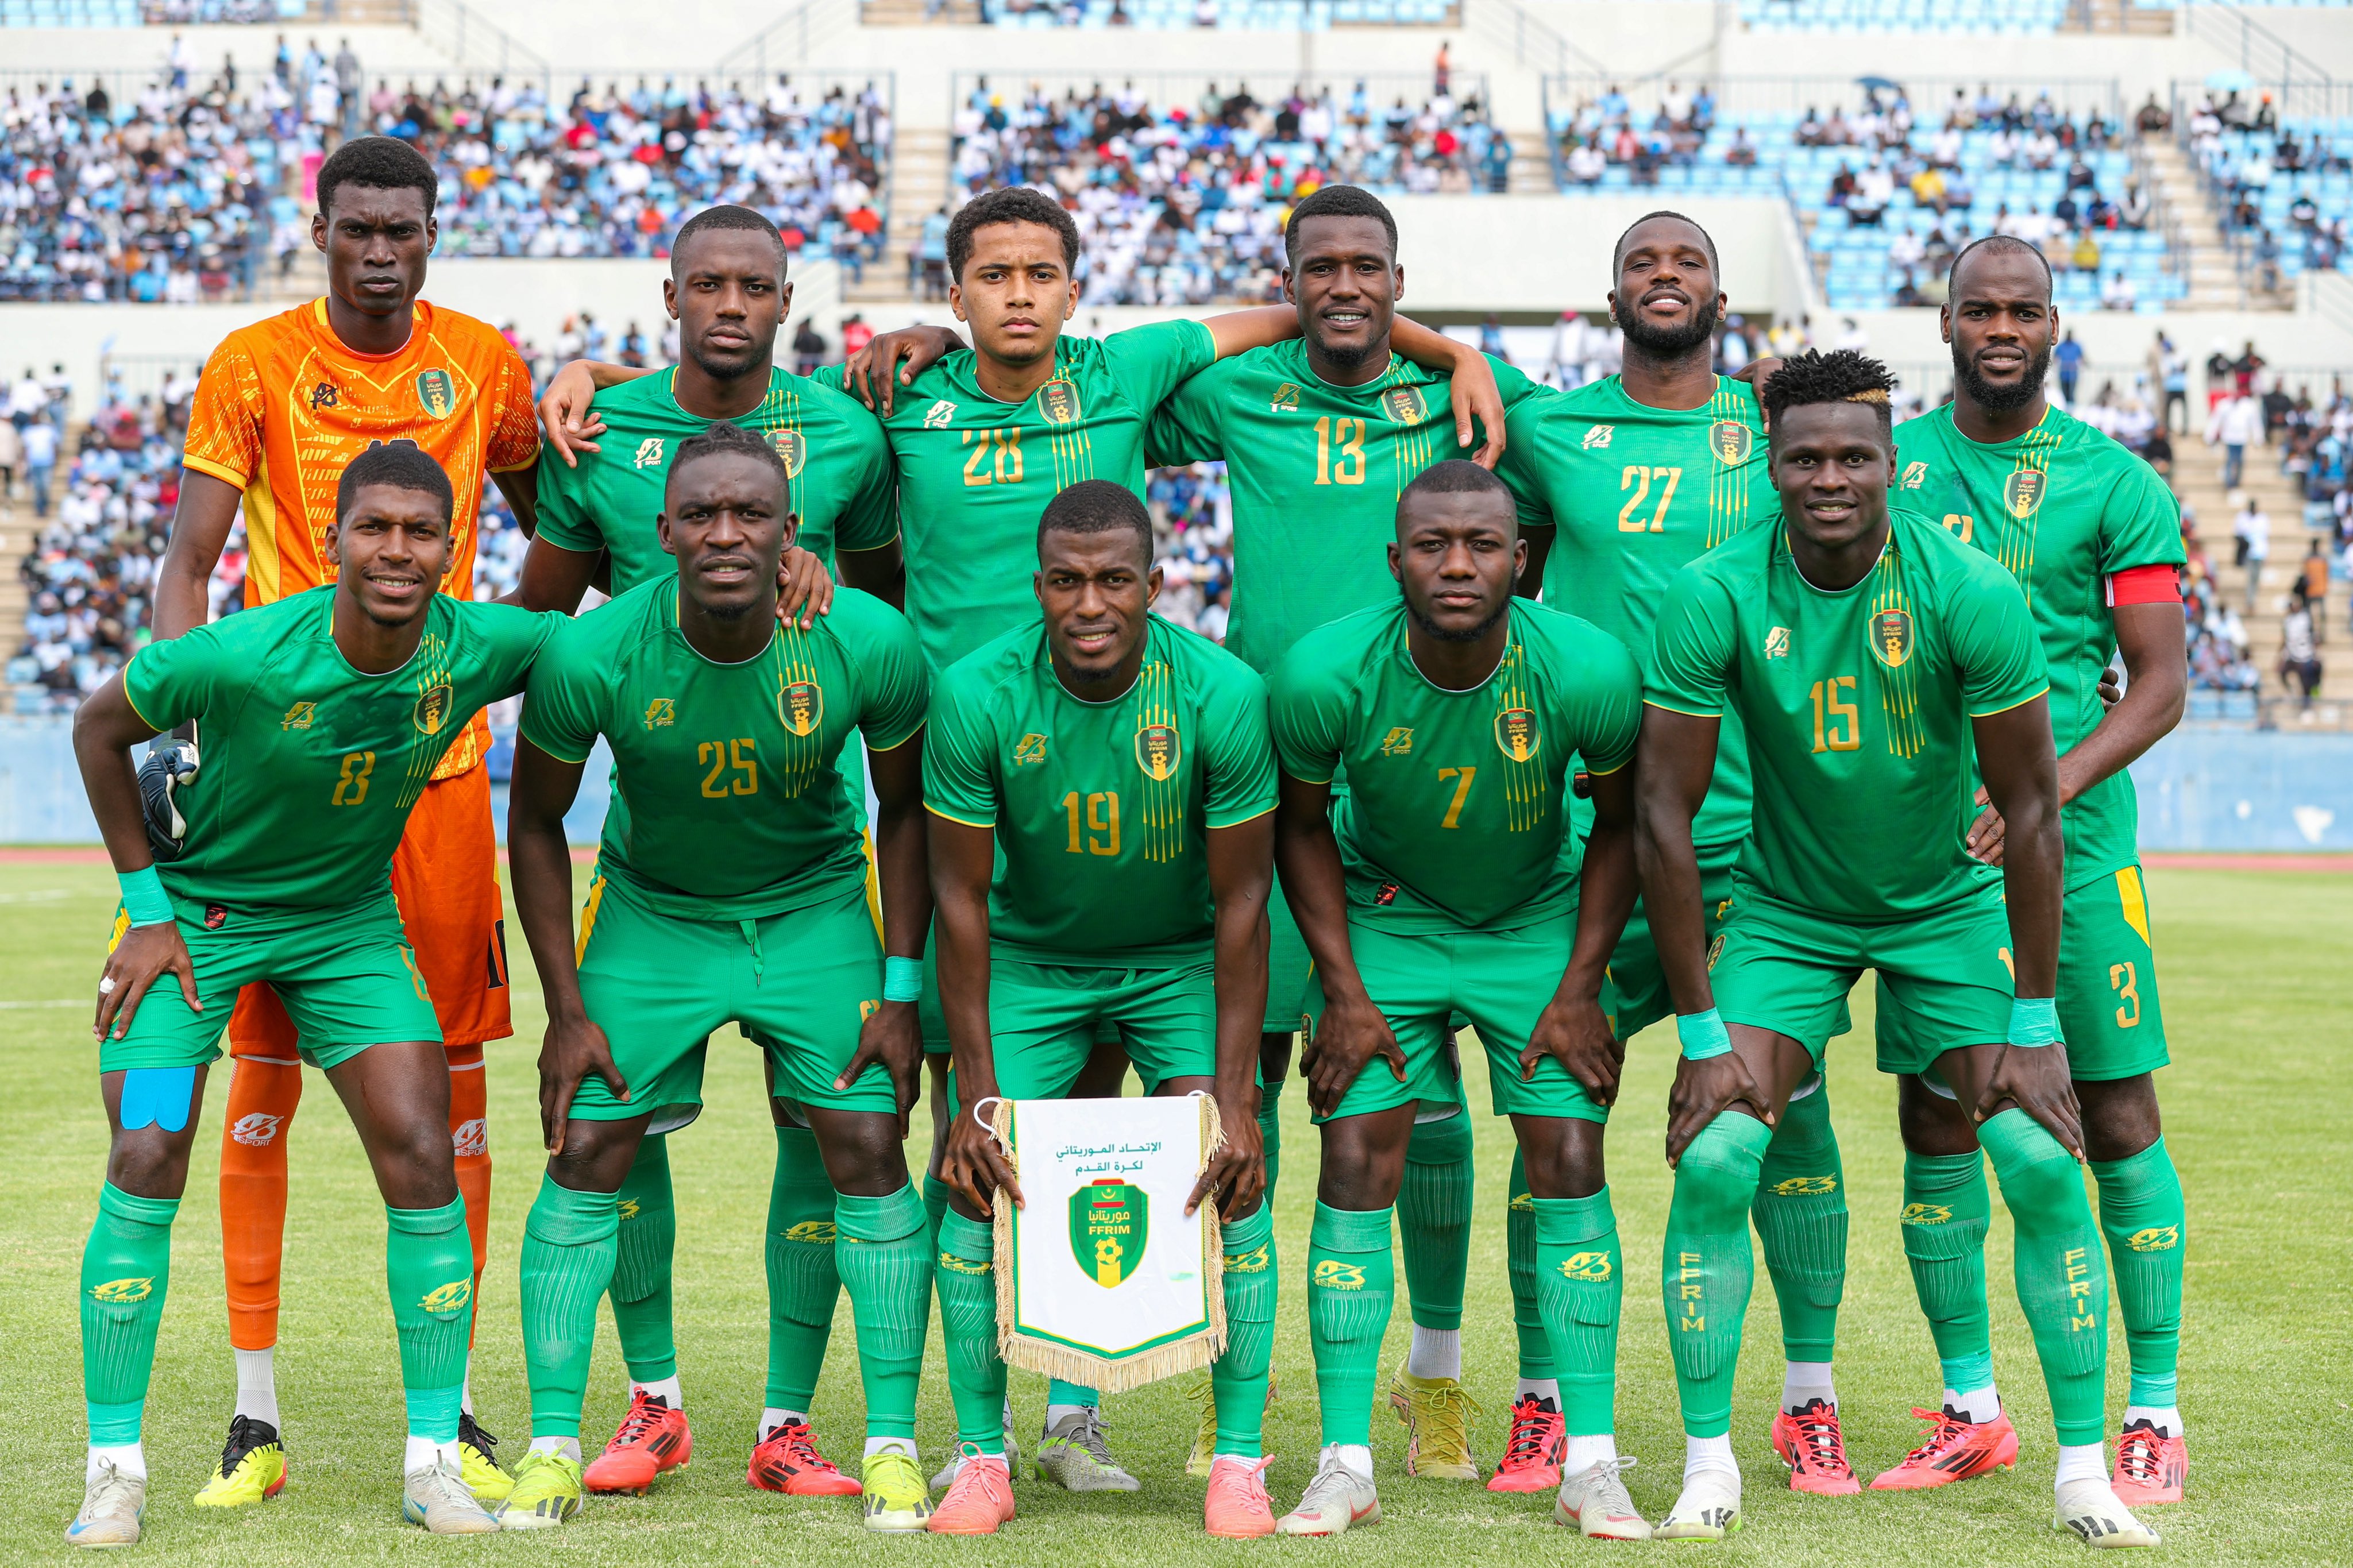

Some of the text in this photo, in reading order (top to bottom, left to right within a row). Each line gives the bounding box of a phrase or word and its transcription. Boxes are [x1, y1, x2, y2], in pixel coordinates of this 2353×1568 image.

[962, 427, 1023, 486] 28
[1313, 416, 1365, 485] 13
[1618, 465, 1683, 532] 27
[1809, 676, 1860, 753] 15
[331, 751, 376, 805] 8
[698, 738, 758, 798] 25
[1062, 791, 1120, 856] 19
[1438, 767, 1476, 828] 7
[2109, 961, 2140, 1029] 3
[238, 1135, 272, 1146] SPORT
[460, 1144, 487, 1157] SPORT
[1075, 1161, 1143, 1176] لكرة القدم
[1089, 1210, 1130, 1225] موريتانيا
[1089, 1225, 1131, 1235] FFRIM
[2141, 1241, 2177, 1252] SPORT
[1320, 1279, 1363, 1291] SPORT
[1571, 1273, 1610, 1283] SPORT
[1680, 1252, 1704, 1331] FFRIM
[2065, 1248, 2096, 1332] FFRIM
[2169, 1450, 2183, 1462] F5
